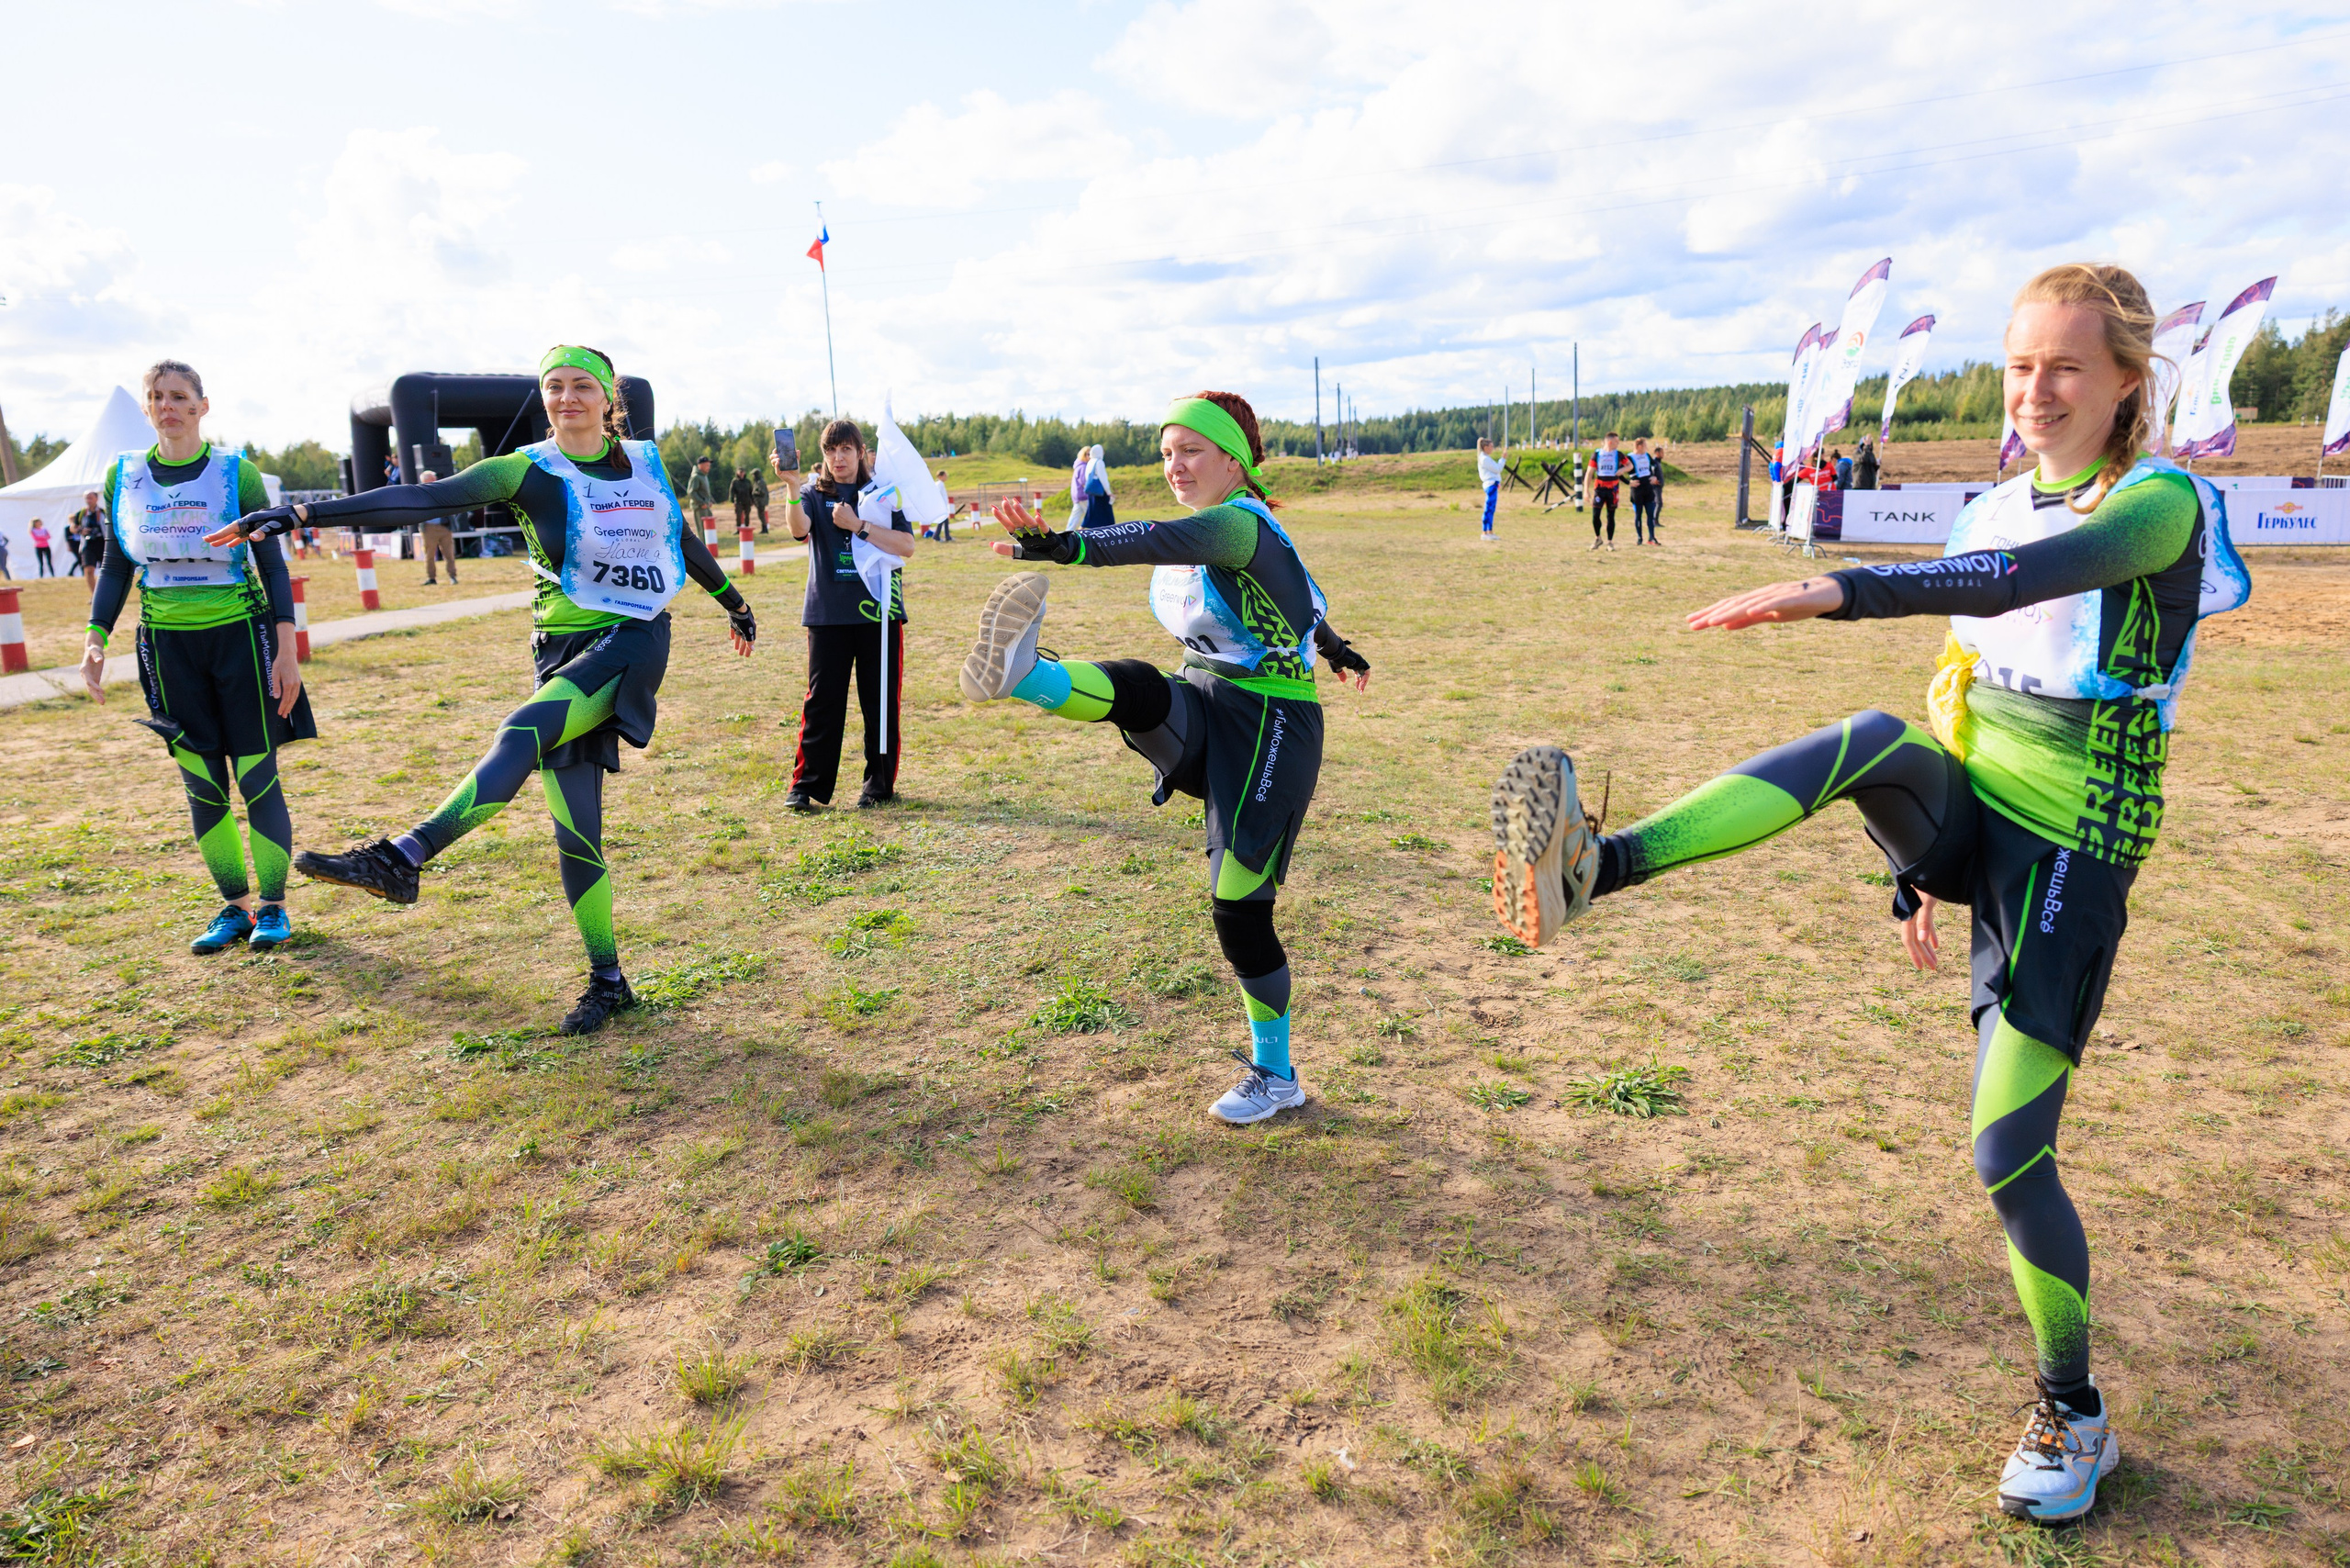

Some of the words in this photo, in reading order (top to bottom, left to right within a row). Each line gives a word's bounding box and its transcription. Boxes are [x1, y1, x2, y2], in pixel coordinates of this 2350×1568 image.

[582, 482, 596, 498] 1
[146, 502, 171, 511] ГОНКА
[590, 501, 621, 511] ГОНКА
[622, 499, 655, 508] ГЕРОЕВ
[1987, 488, 2018, 521] 1
[1869, 511, 1936, 522] TANK
[139, 524, 203, 535] Greenway
[593, 525, 652, 540] Greenway
[1862, 552, 2000, 579] Greenway
[592, 560, 666, 594] 7360
[1922, 578, 1983, 588] GLOBAL
[614, 599, 654, 612] ГАЗПРОМБАНК
